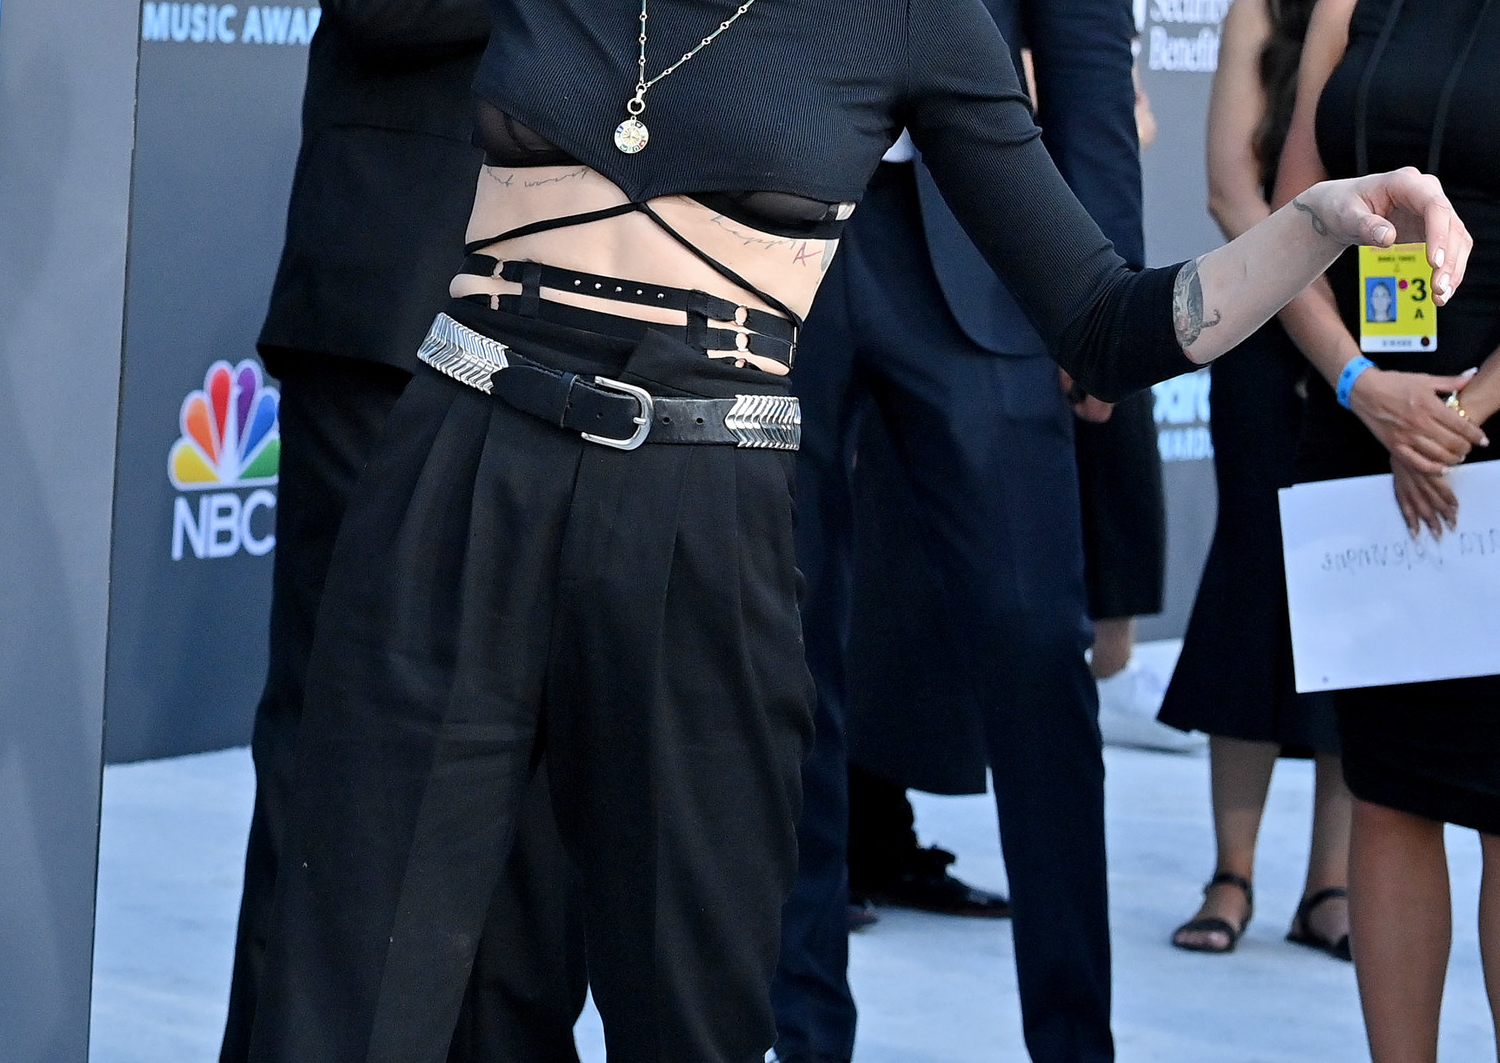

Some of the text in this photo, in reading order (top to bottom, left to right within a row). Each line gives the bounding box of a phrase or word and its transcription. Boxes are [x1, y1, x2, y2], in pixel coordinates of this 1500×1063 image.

[142, 1, 238, 44] MUSIC
[1411, 278, 1428, 302] 3
[171, 489, 277, 561] NBC
